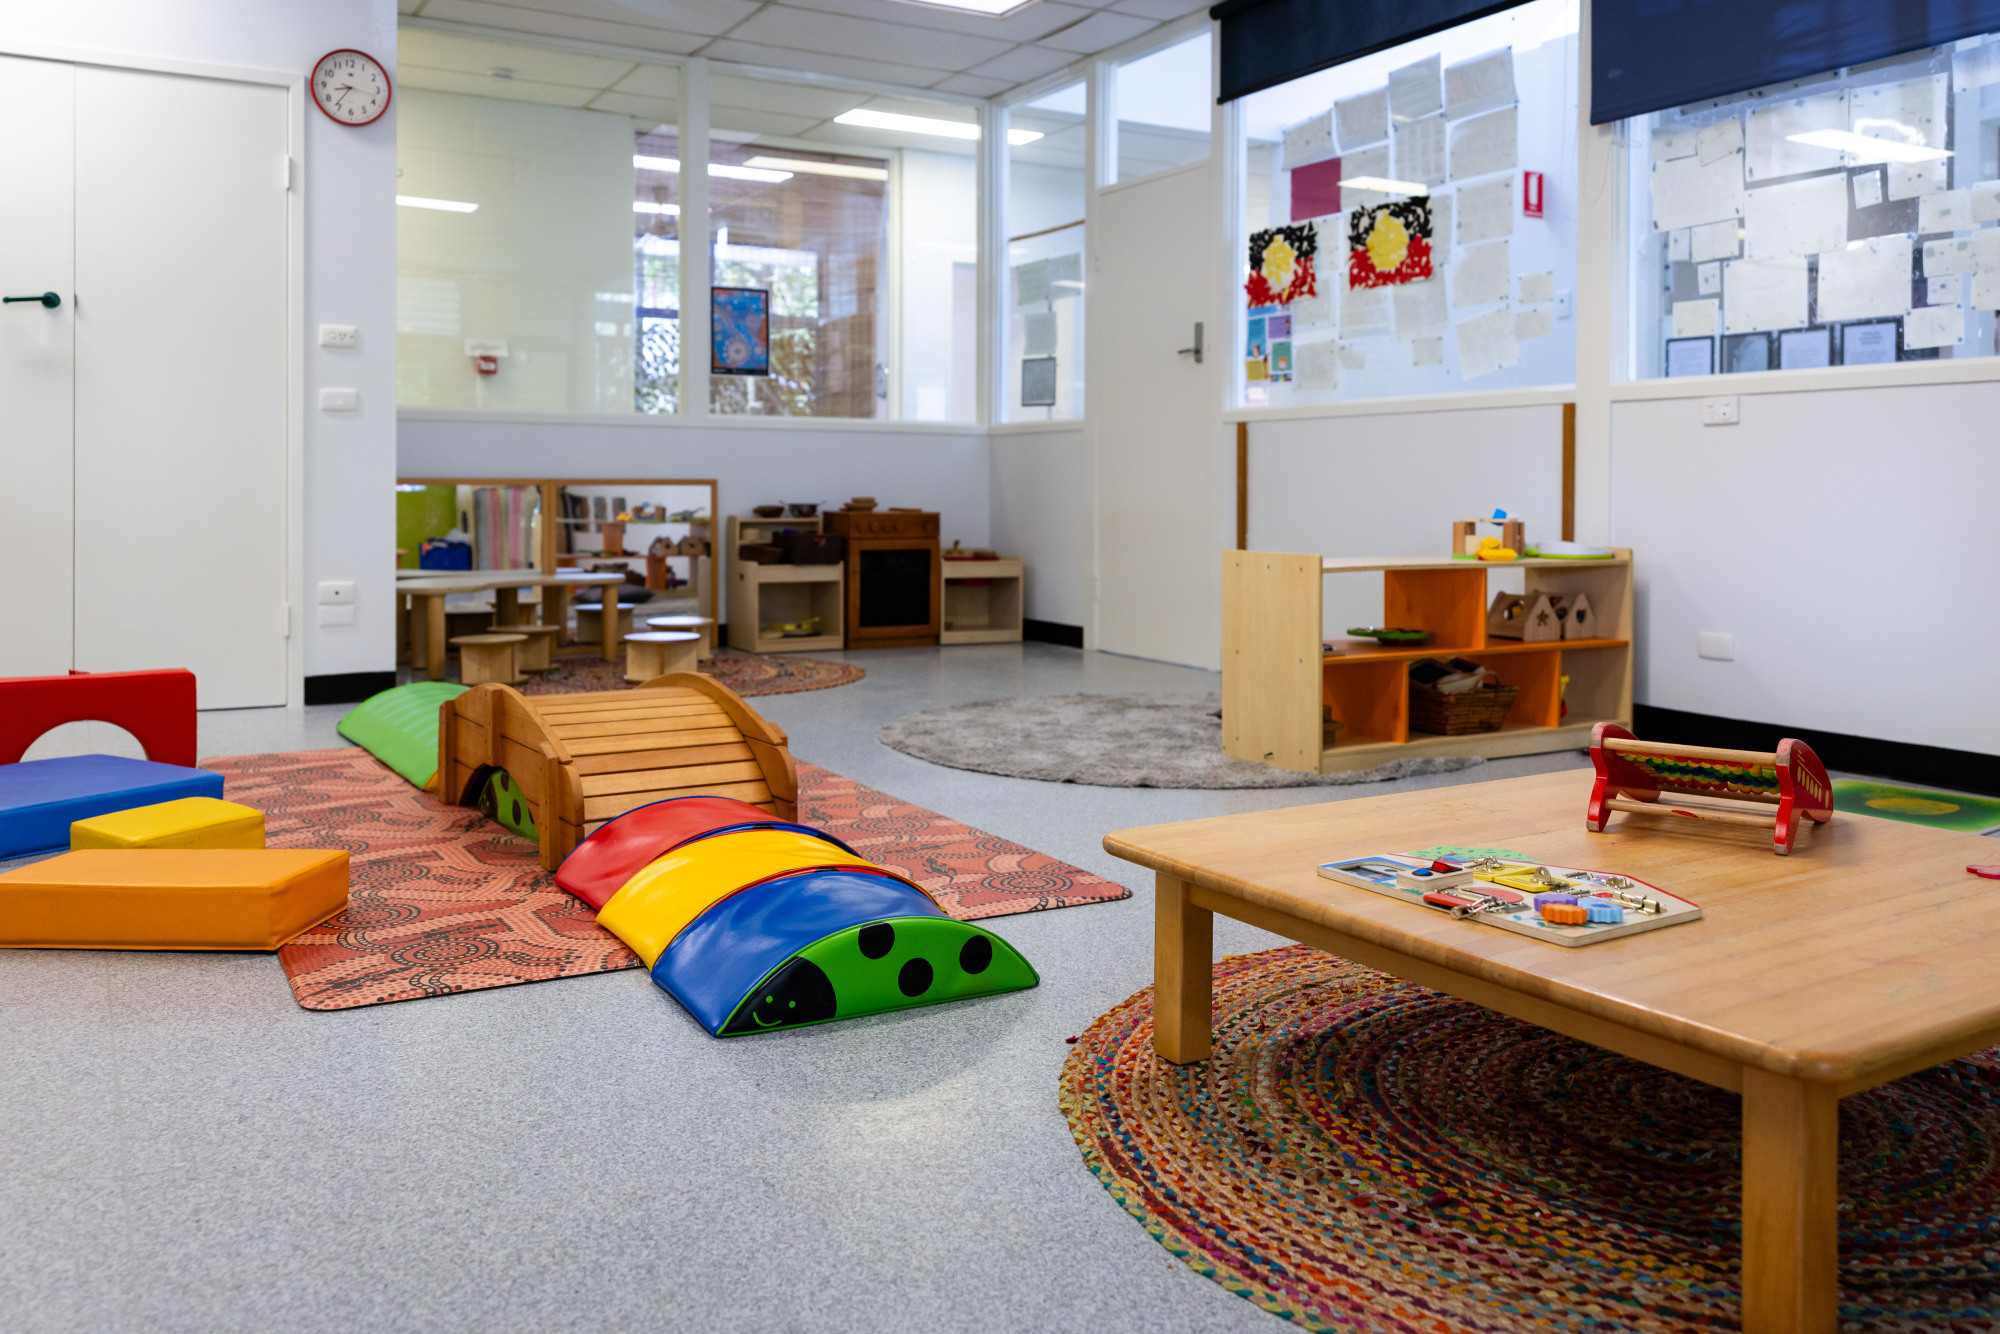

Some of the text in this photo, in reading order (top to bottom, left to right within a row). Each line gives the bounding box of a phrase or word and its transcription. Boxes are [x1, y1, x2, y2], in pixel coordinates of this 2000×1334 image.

[334, 61, 341, 70] 11
[345, 59, 355, 68] 12
[361, 63, 365, 72] 1
[325, 69, 334, 78] 10
[371, 73, 376, 82] 2
[321, 80, 327, 89] 9
[376, 86, 380, 95] 3
[326, 94, 332, 102] 8
[371, 98, 376, 106] 4
[337, 103, 342, 112] 7
[348, 108, 354, 116] 6
[362, 105, 367, 114] 5
